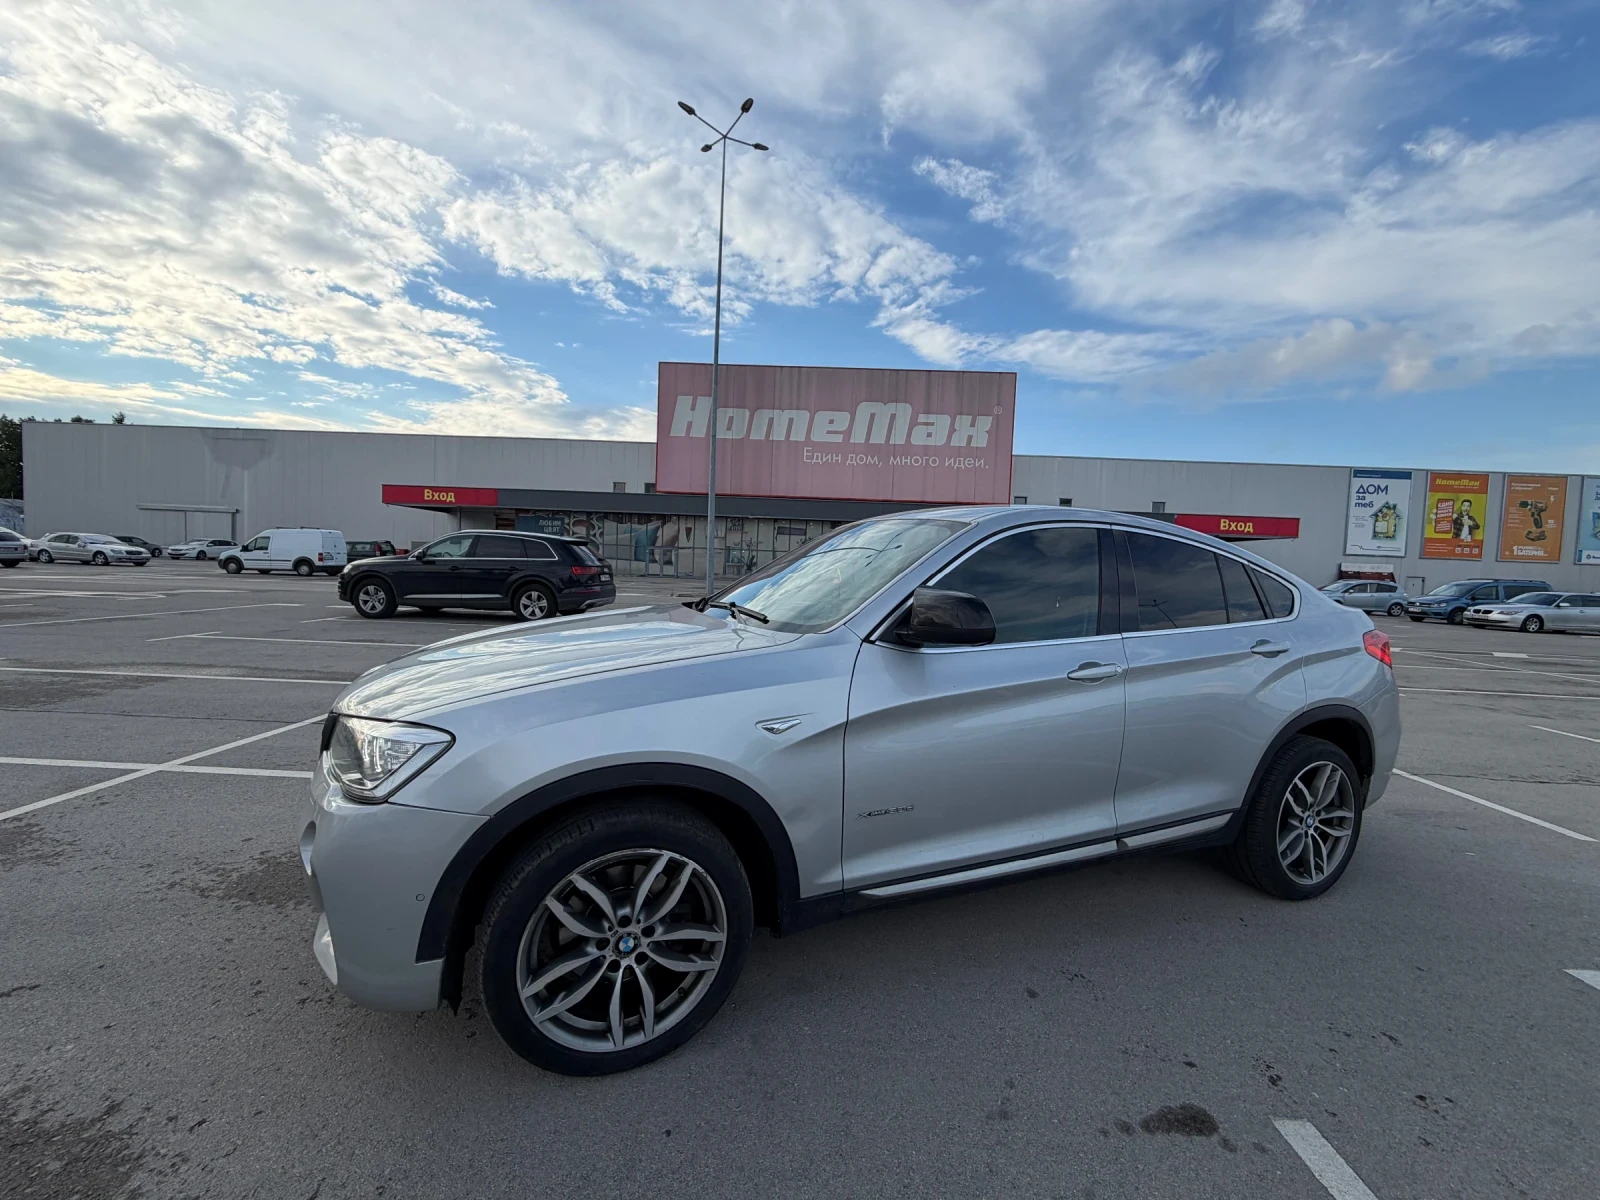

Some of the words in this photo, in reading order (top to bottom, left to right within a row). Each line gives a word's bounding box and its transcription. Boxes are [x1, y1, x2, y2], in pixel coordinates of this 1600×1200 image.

[803, 447, 842, 465] Един
[846, 453, 883, 468] дом,
[889, 455, 940, 467] много
[945, 457, 989, 469] идеи.
[424, 488, 455, 502] Вход
[1355, 483, 1389, 495] ДОМ
[1220, 518, 1254, 533] Вход
